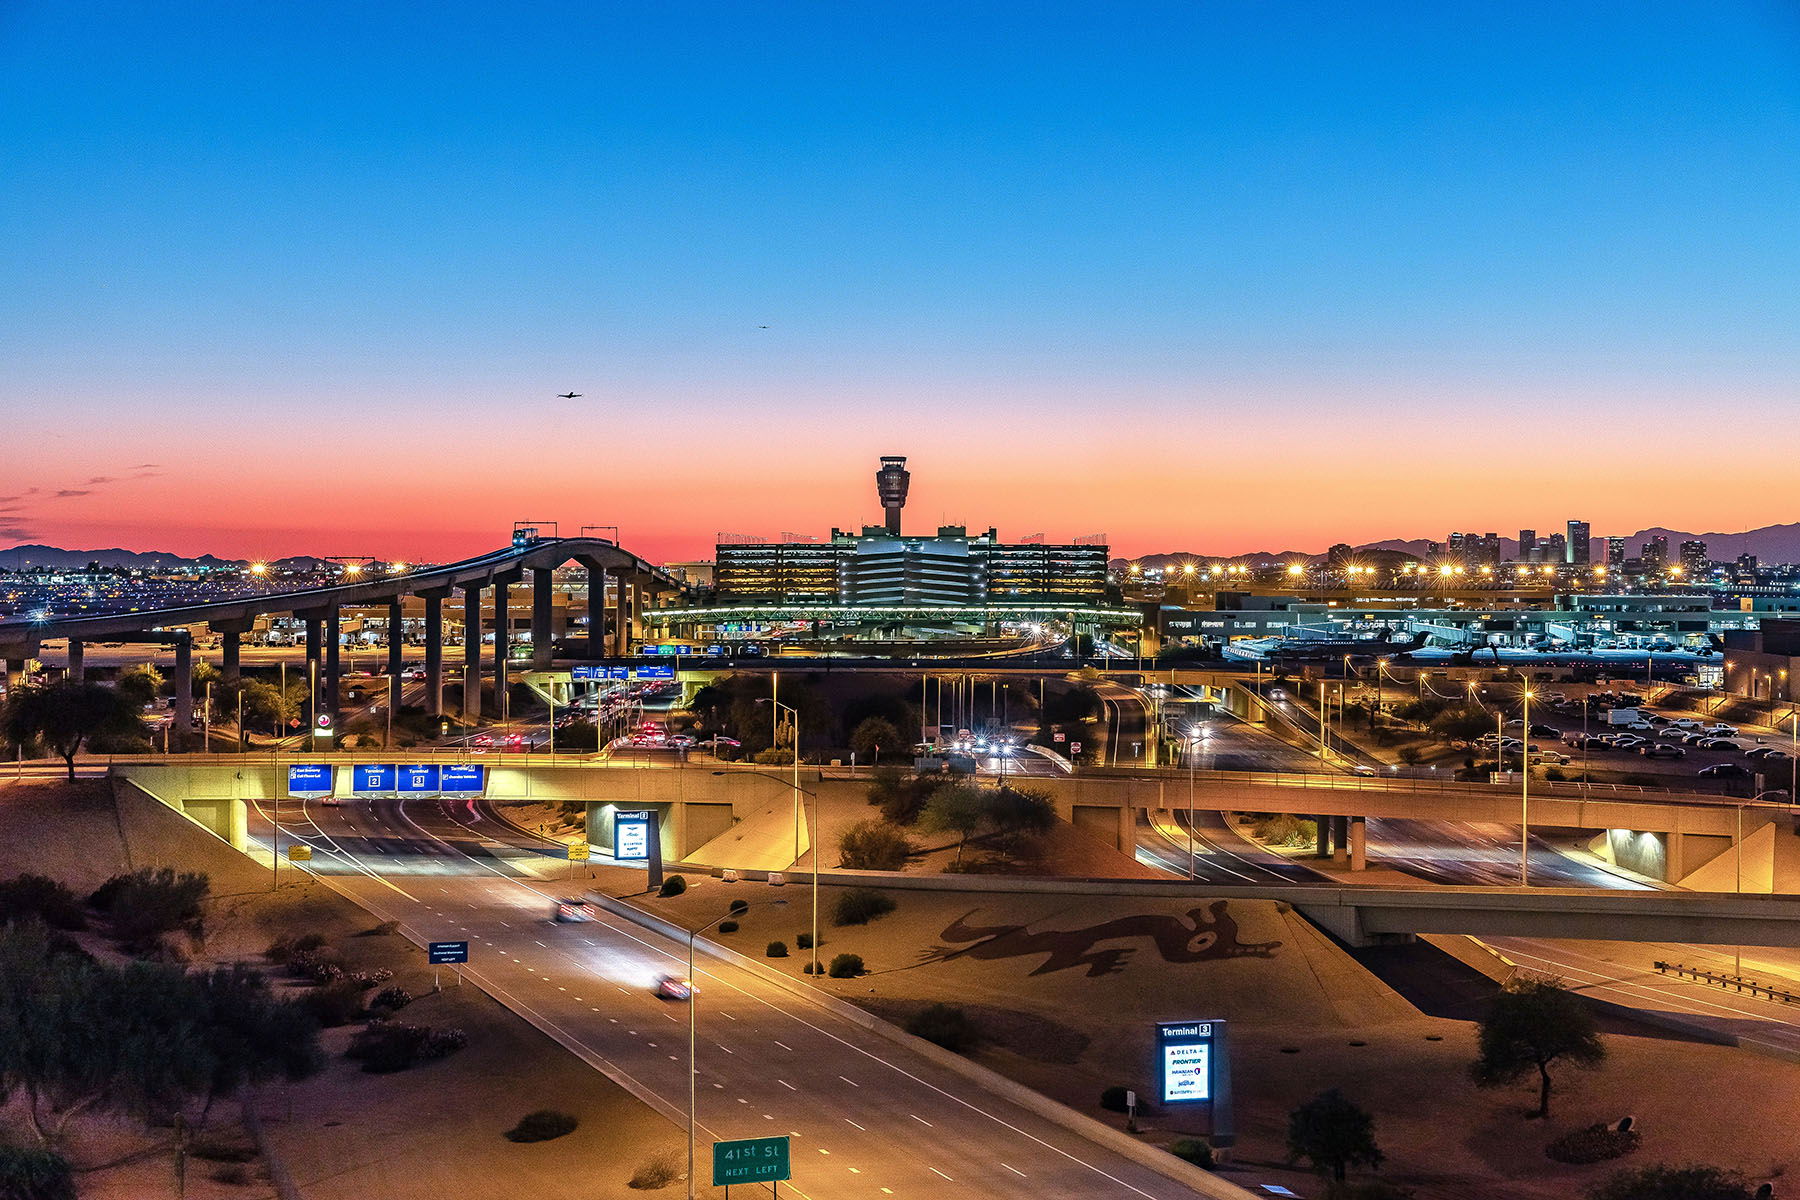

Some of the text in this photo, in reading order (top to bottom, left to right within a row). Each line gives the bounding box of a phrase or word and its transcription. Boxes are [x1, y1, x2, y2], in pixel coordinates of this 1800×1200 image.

[1162, 1027, 1198, 1036] Terminal
[725, 1145, 779, 1160] 41st St
[726, 1165, 777, 1176] NEXT LEFT
